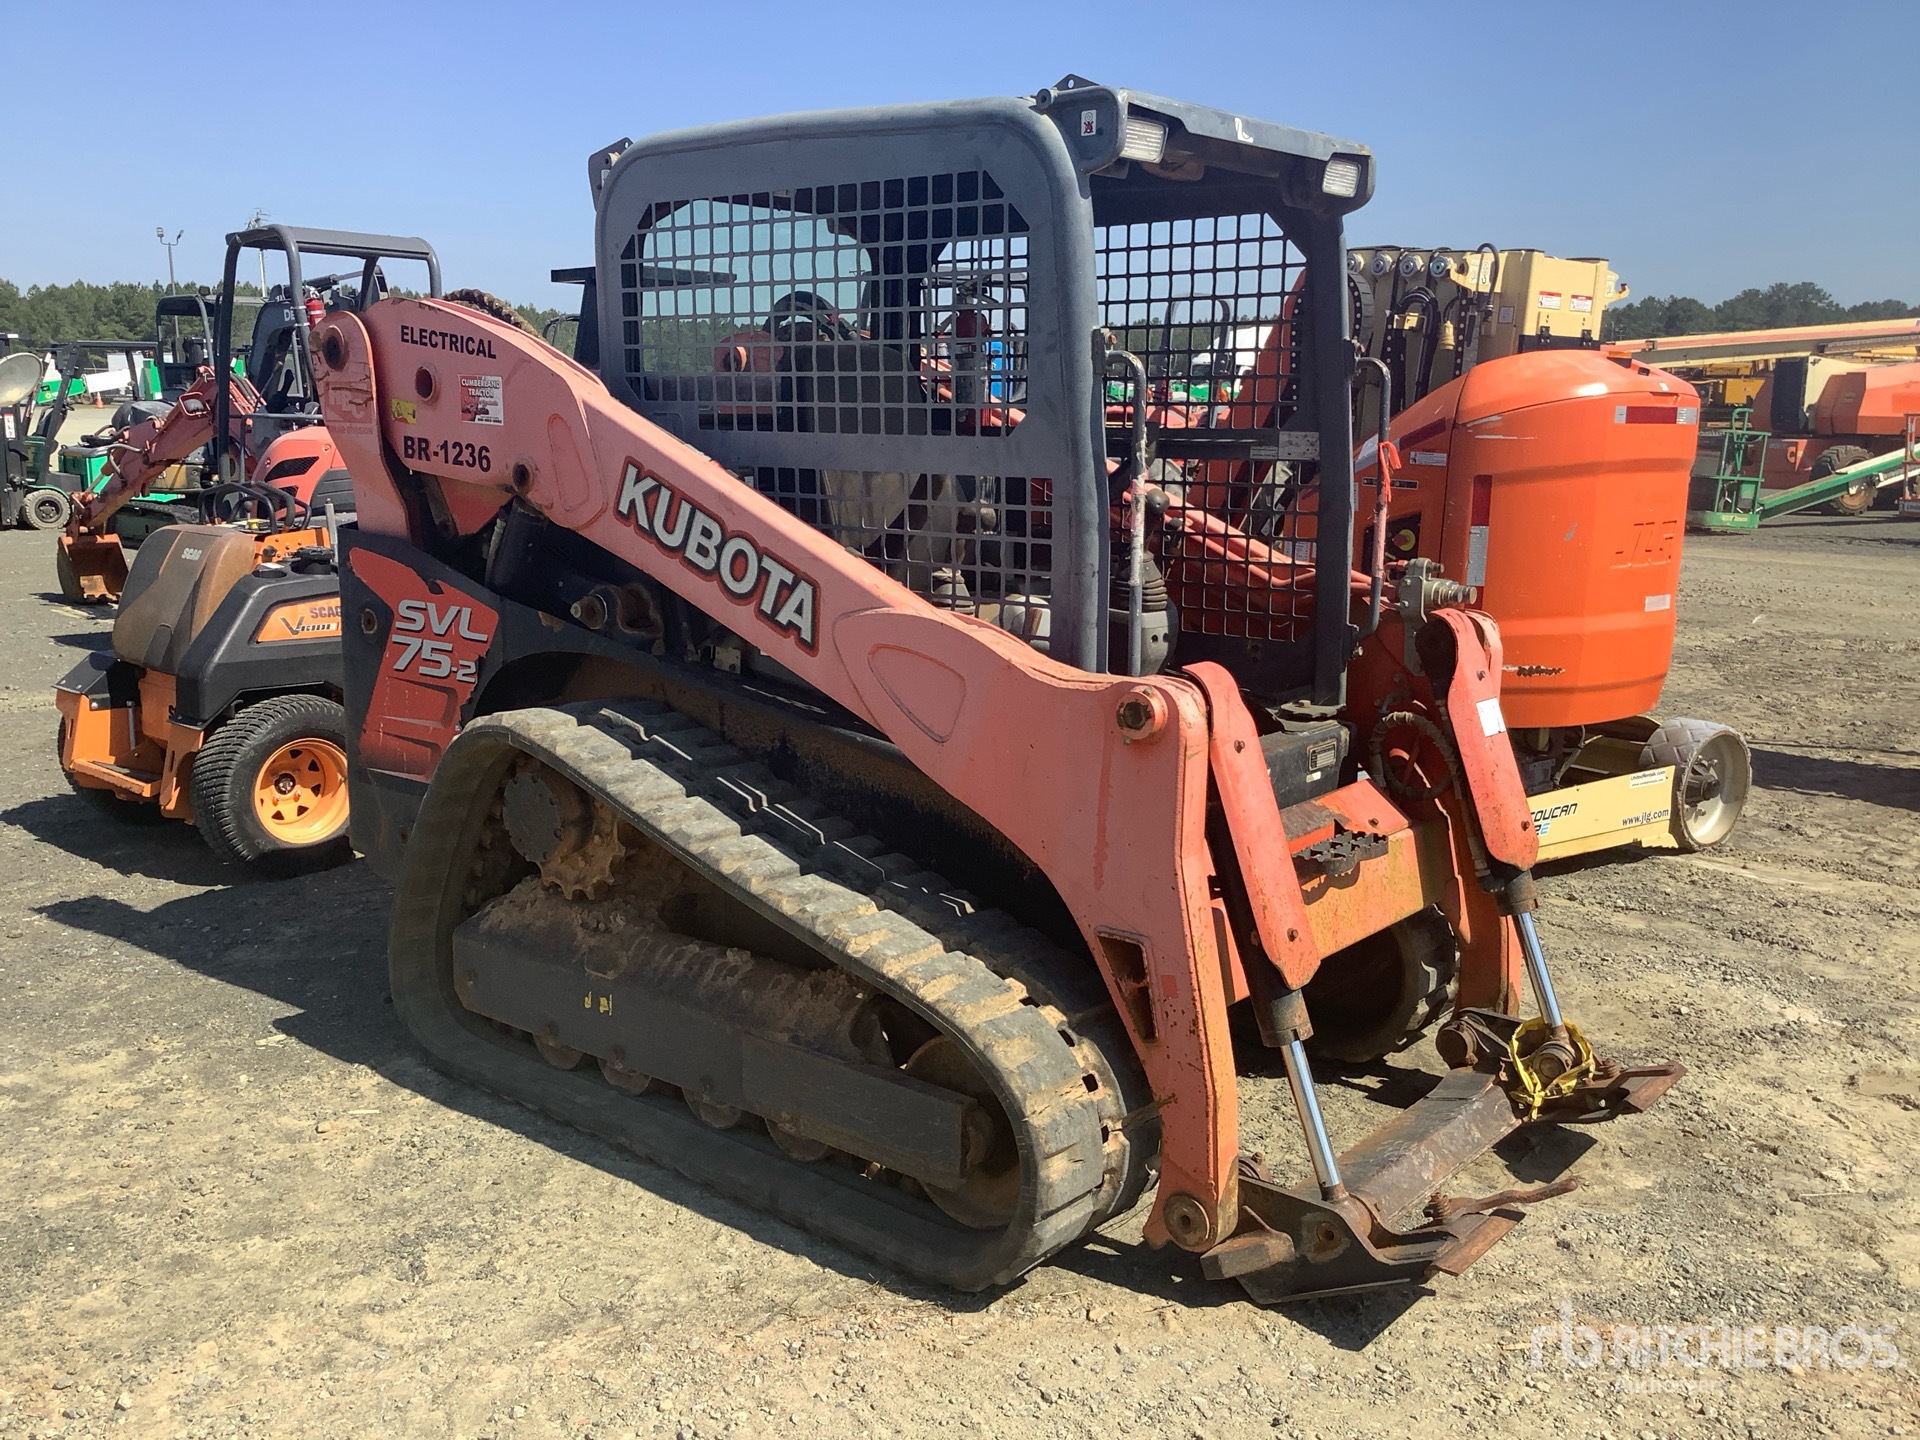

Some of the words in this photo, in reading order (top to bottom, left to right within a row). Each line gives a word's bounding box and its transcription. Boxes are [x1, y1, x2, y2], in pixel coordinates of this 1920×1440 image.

[400, 324, 496, 359] ELECTRICAL
[461, 378, 501, 389] CUMBERLAND
[468, 388, 494, 398] TRACTOR
[403, 434, 491, 473] BR-1236
[616, 461, 817, 647] KUBOTA
[1609, 520, 1677, 569] JLG
[395, 599, 488, 642] SVL
[391, 634, 477, 684] 75-2
[1622, 809, 1669, 826] www.jlg.com
